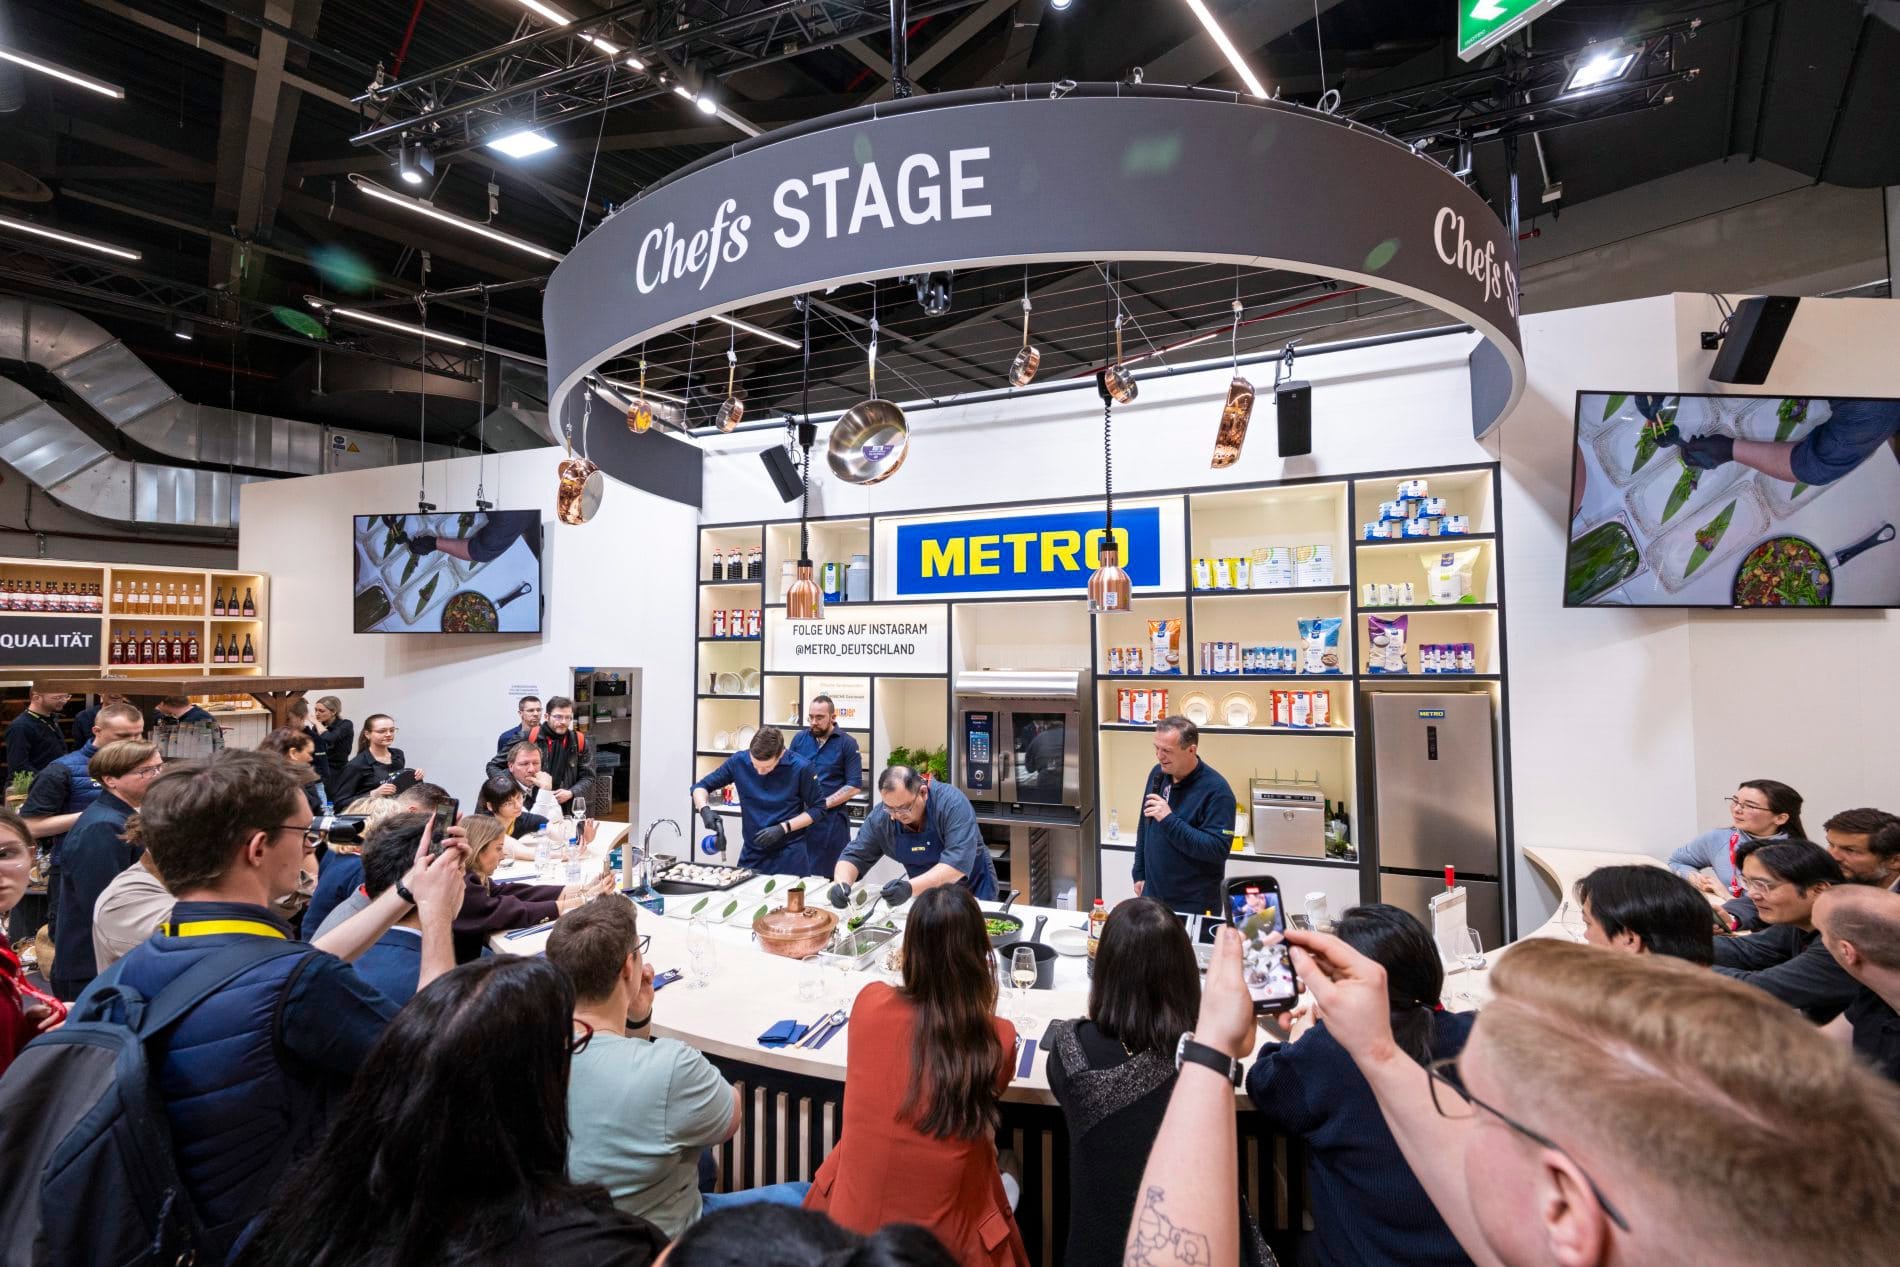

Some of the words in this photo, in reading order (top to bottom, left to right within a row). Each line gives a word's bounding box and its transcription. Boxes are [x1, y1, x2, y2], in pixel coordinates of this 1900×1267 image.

[635, 198, 751, 295] Chefs
[773, 146, 992, 249] STAGE
[1433, 206, 1501, 303] Chefs
[921, 527, 1129, 578] METRO
[0, 631, 93, 649] QUALITÄT
[793, 624, 823, 636] FOLGE
[825, 624, 845, 635] UNS
[847, 623, 867, 635] AUF
[869, 623, 928, 635] INSTAGRAM
[795, 643, 915, 657] @METRO_DEUTSCHLAND
